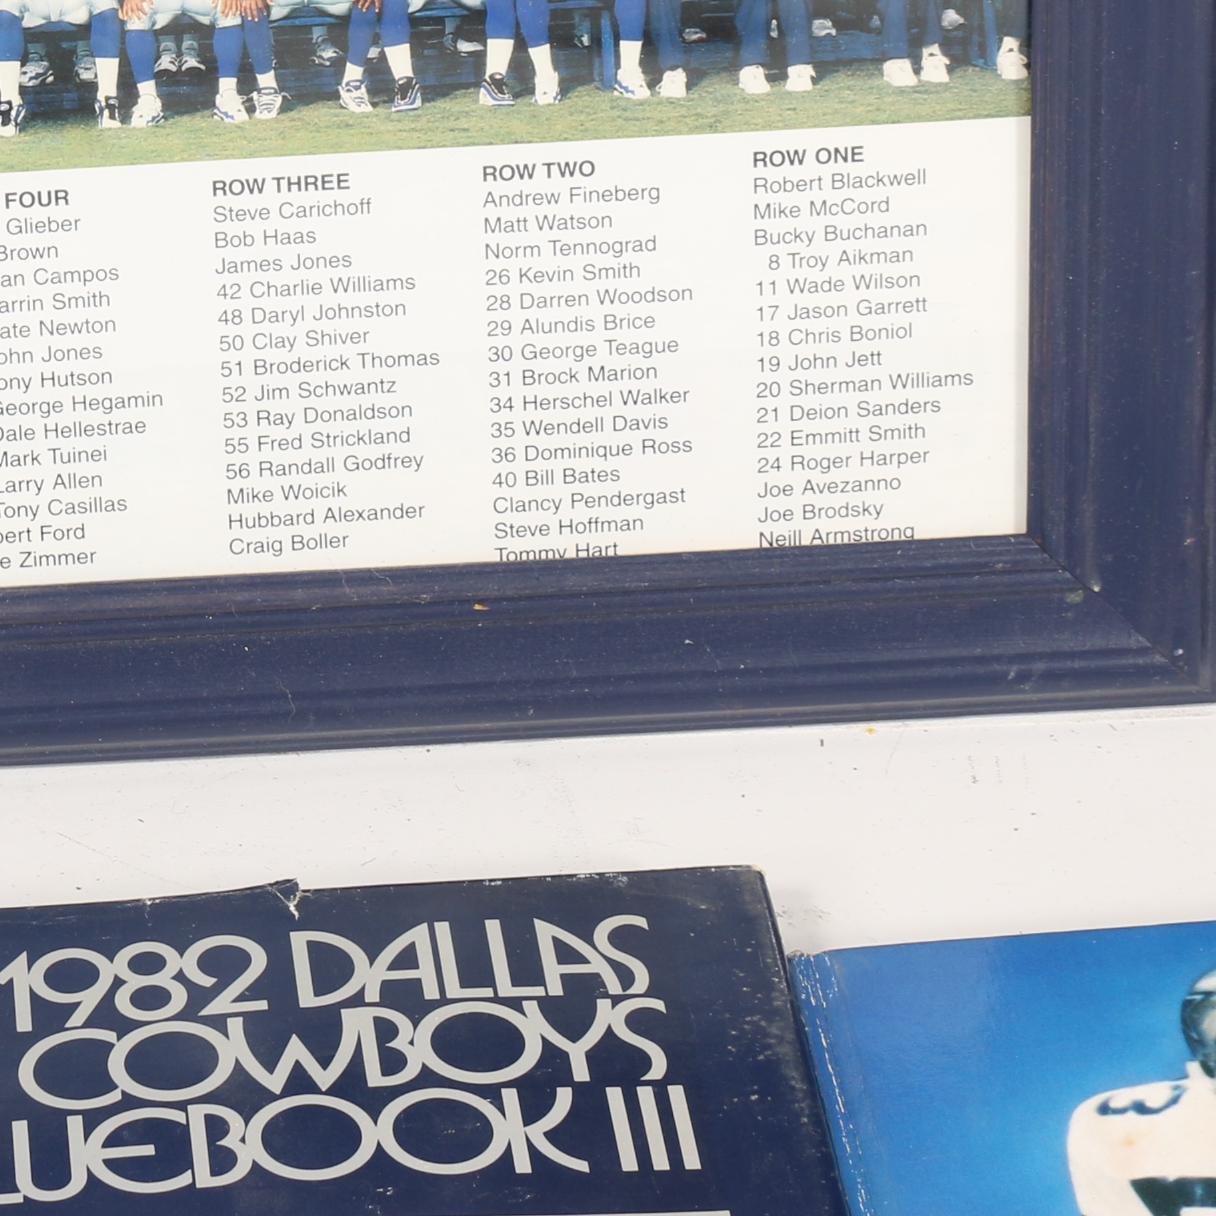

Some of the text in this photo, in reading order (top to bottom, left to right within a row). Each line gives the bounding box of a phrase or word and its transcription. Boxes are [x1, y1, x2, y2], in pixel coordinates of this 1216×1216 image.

[752, 145, 865, 169] ROW ONE
[482, 159, 596, 183] ROW TWO
[212, 172, 351, 197] ROW THREE
[482, 185, 660, 208] Andrew Fineberg
[4, 189, 70, 210] FOUR
[213, 197, 371, 223] Steve Carichoff
[753, 196, 890, 220] Mike McCord
[6, 216, 81, 236] Glieber
[216, 276, 416, 300] 42 Charlie Williams
[756, 273, 921, 297] 11 Wade Wilson
[52, 290, 111, 311] Smith
[486, 286, 693, 312] 28 Darren Woodson
[757, 322, 912, 347] 18 Chris Boniol
[41, 345, 103, 363] Jones
[220, 352, 440, 378] 51 Broderick Thomas
[489, 365, 658, 388] 31 Brock Marion
[756, 372, 974, 399] 20 Sherman Williams
[223, 403, 413, 430] 53 Ray Donaldson
[490, 415, 669, 439] 35 Wendell Davis
[43, 420, 147, 440] Hellestrae
[225, 452, 424, 480] 56 Randall Godfrey
[757, 450, 930, 474] 24 Roger Harper
[492, 467, 621, 488] 40 Bill Bates
[47, 496, 128, 516] Casillas
[290, 915, 649, 1009] DALLAS
[18, 998, 667, 1110] COWBOYS
[608, 1085, 702, 1173] III
